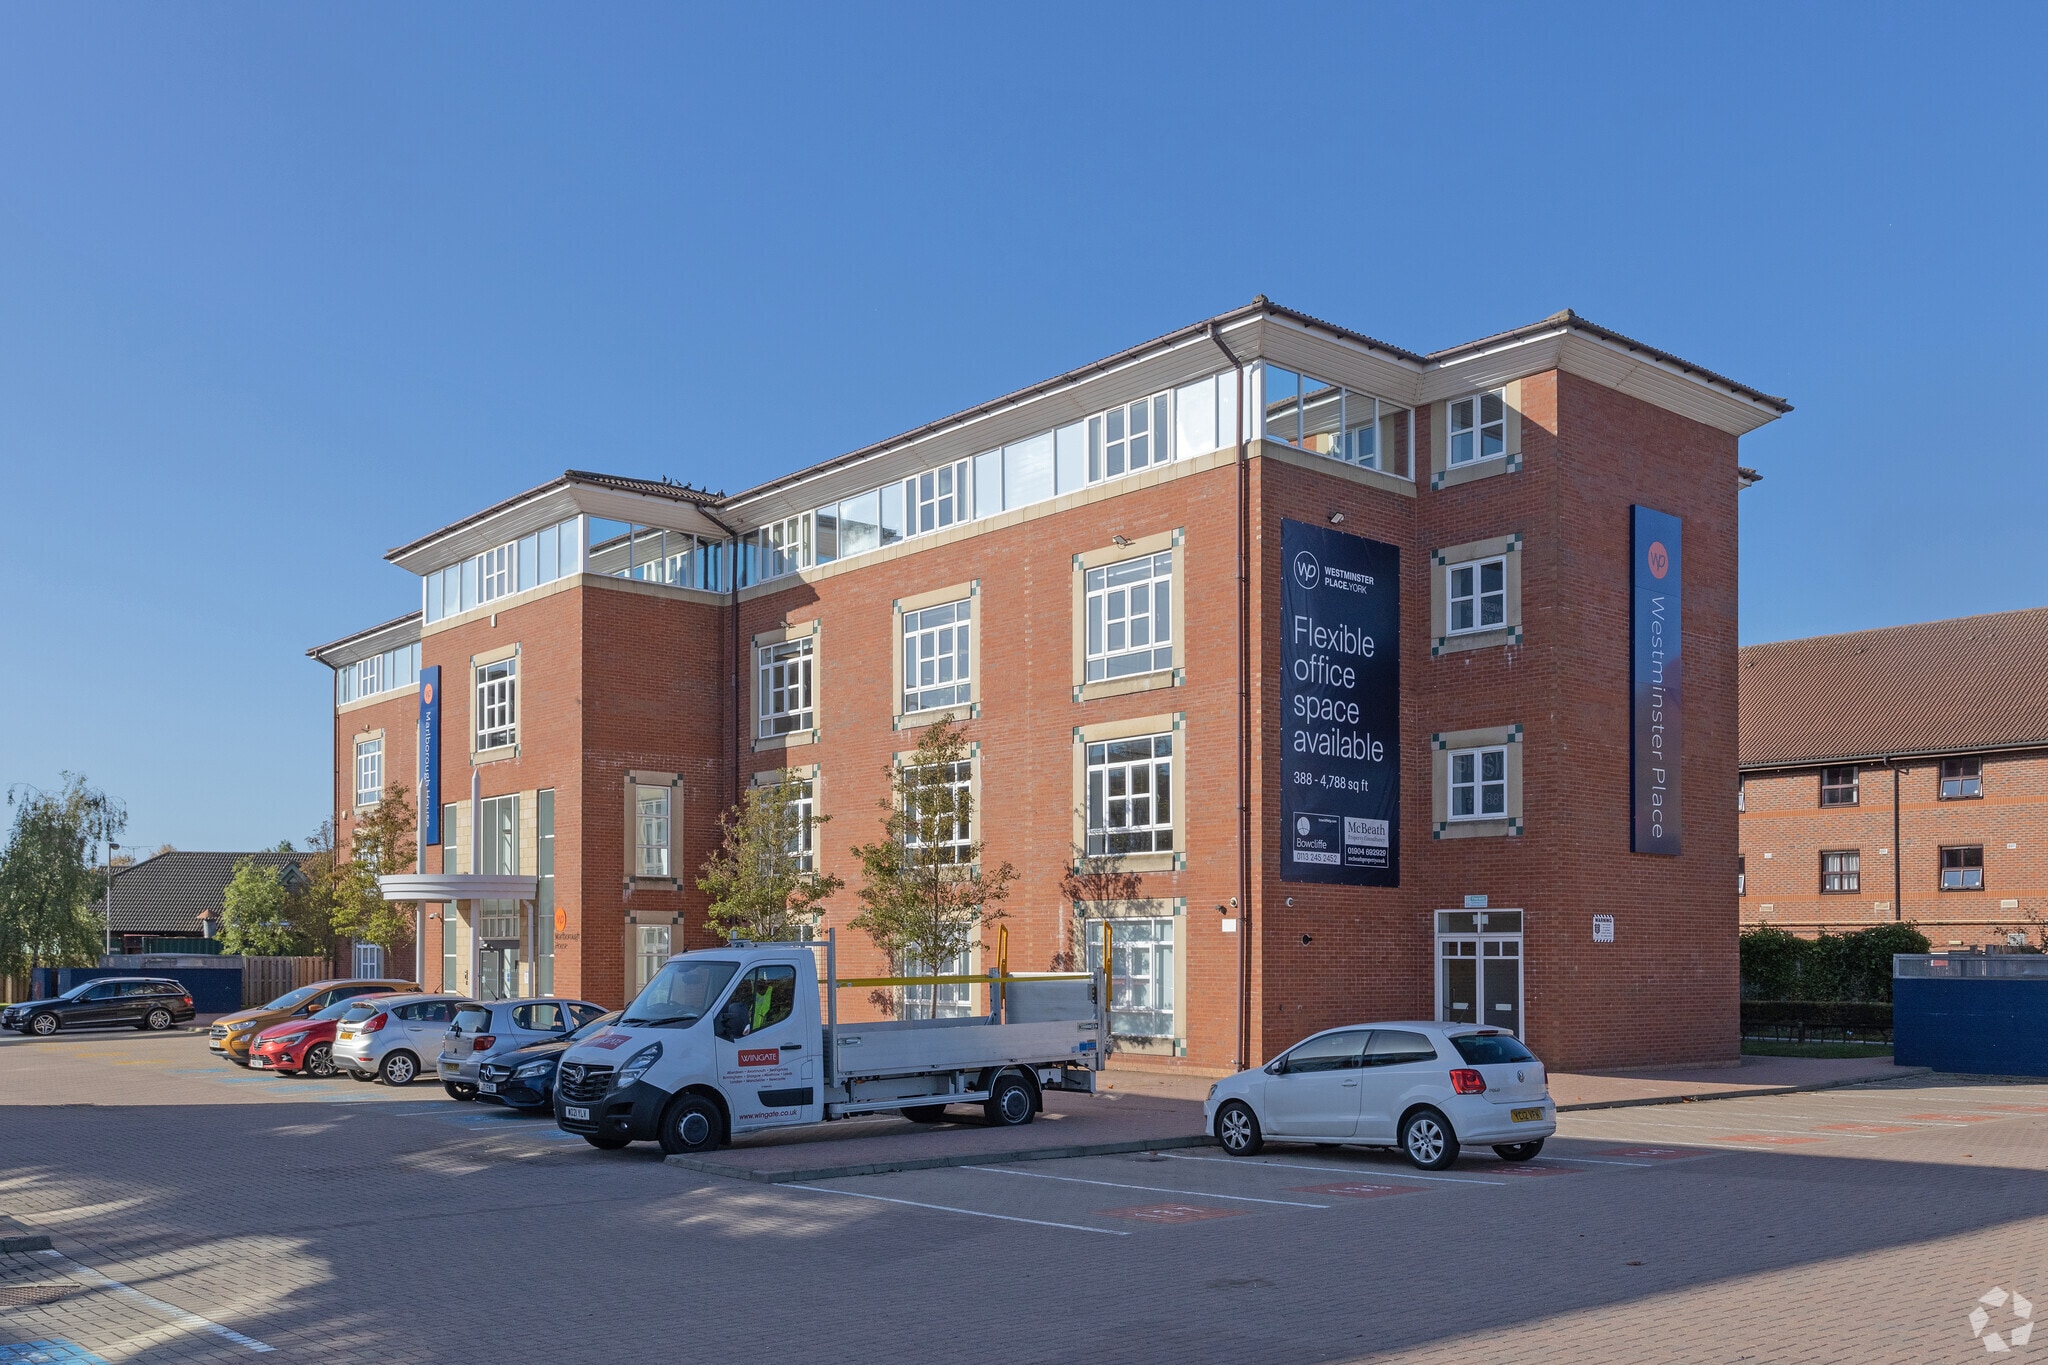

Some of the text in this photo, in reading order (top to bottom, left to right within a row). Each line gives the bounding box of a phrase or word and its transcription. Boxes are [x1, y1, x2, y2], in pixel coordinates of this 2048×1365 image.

[1325, 566, 1374, 585] WESTMINSTER
[1295, 615, 1374, 658] Flexible
[1294, 654, 1355, 688] office
[1294, 694, 1359, 724] space
[1652, 597, 1666, 838] Westminster Place
[1294, 728, 1383, 762] available
[1294, 772, 1312, 785] 388
[1320, 774, 1346, 789] 4,788
[1348, 780, 1359, 793] sq
[1361, 779, 1368, 791] ft
[1348, 822, 1385, 836] McBeath
[1296, 838, 1327, 849] Bowcliffe
[1297, 852, 1337, 863] 0113 245 2452
[741, 1053, 776, 1062] WINGATE
[739, 1110, 798, 1120] www.wingate.co.uk
